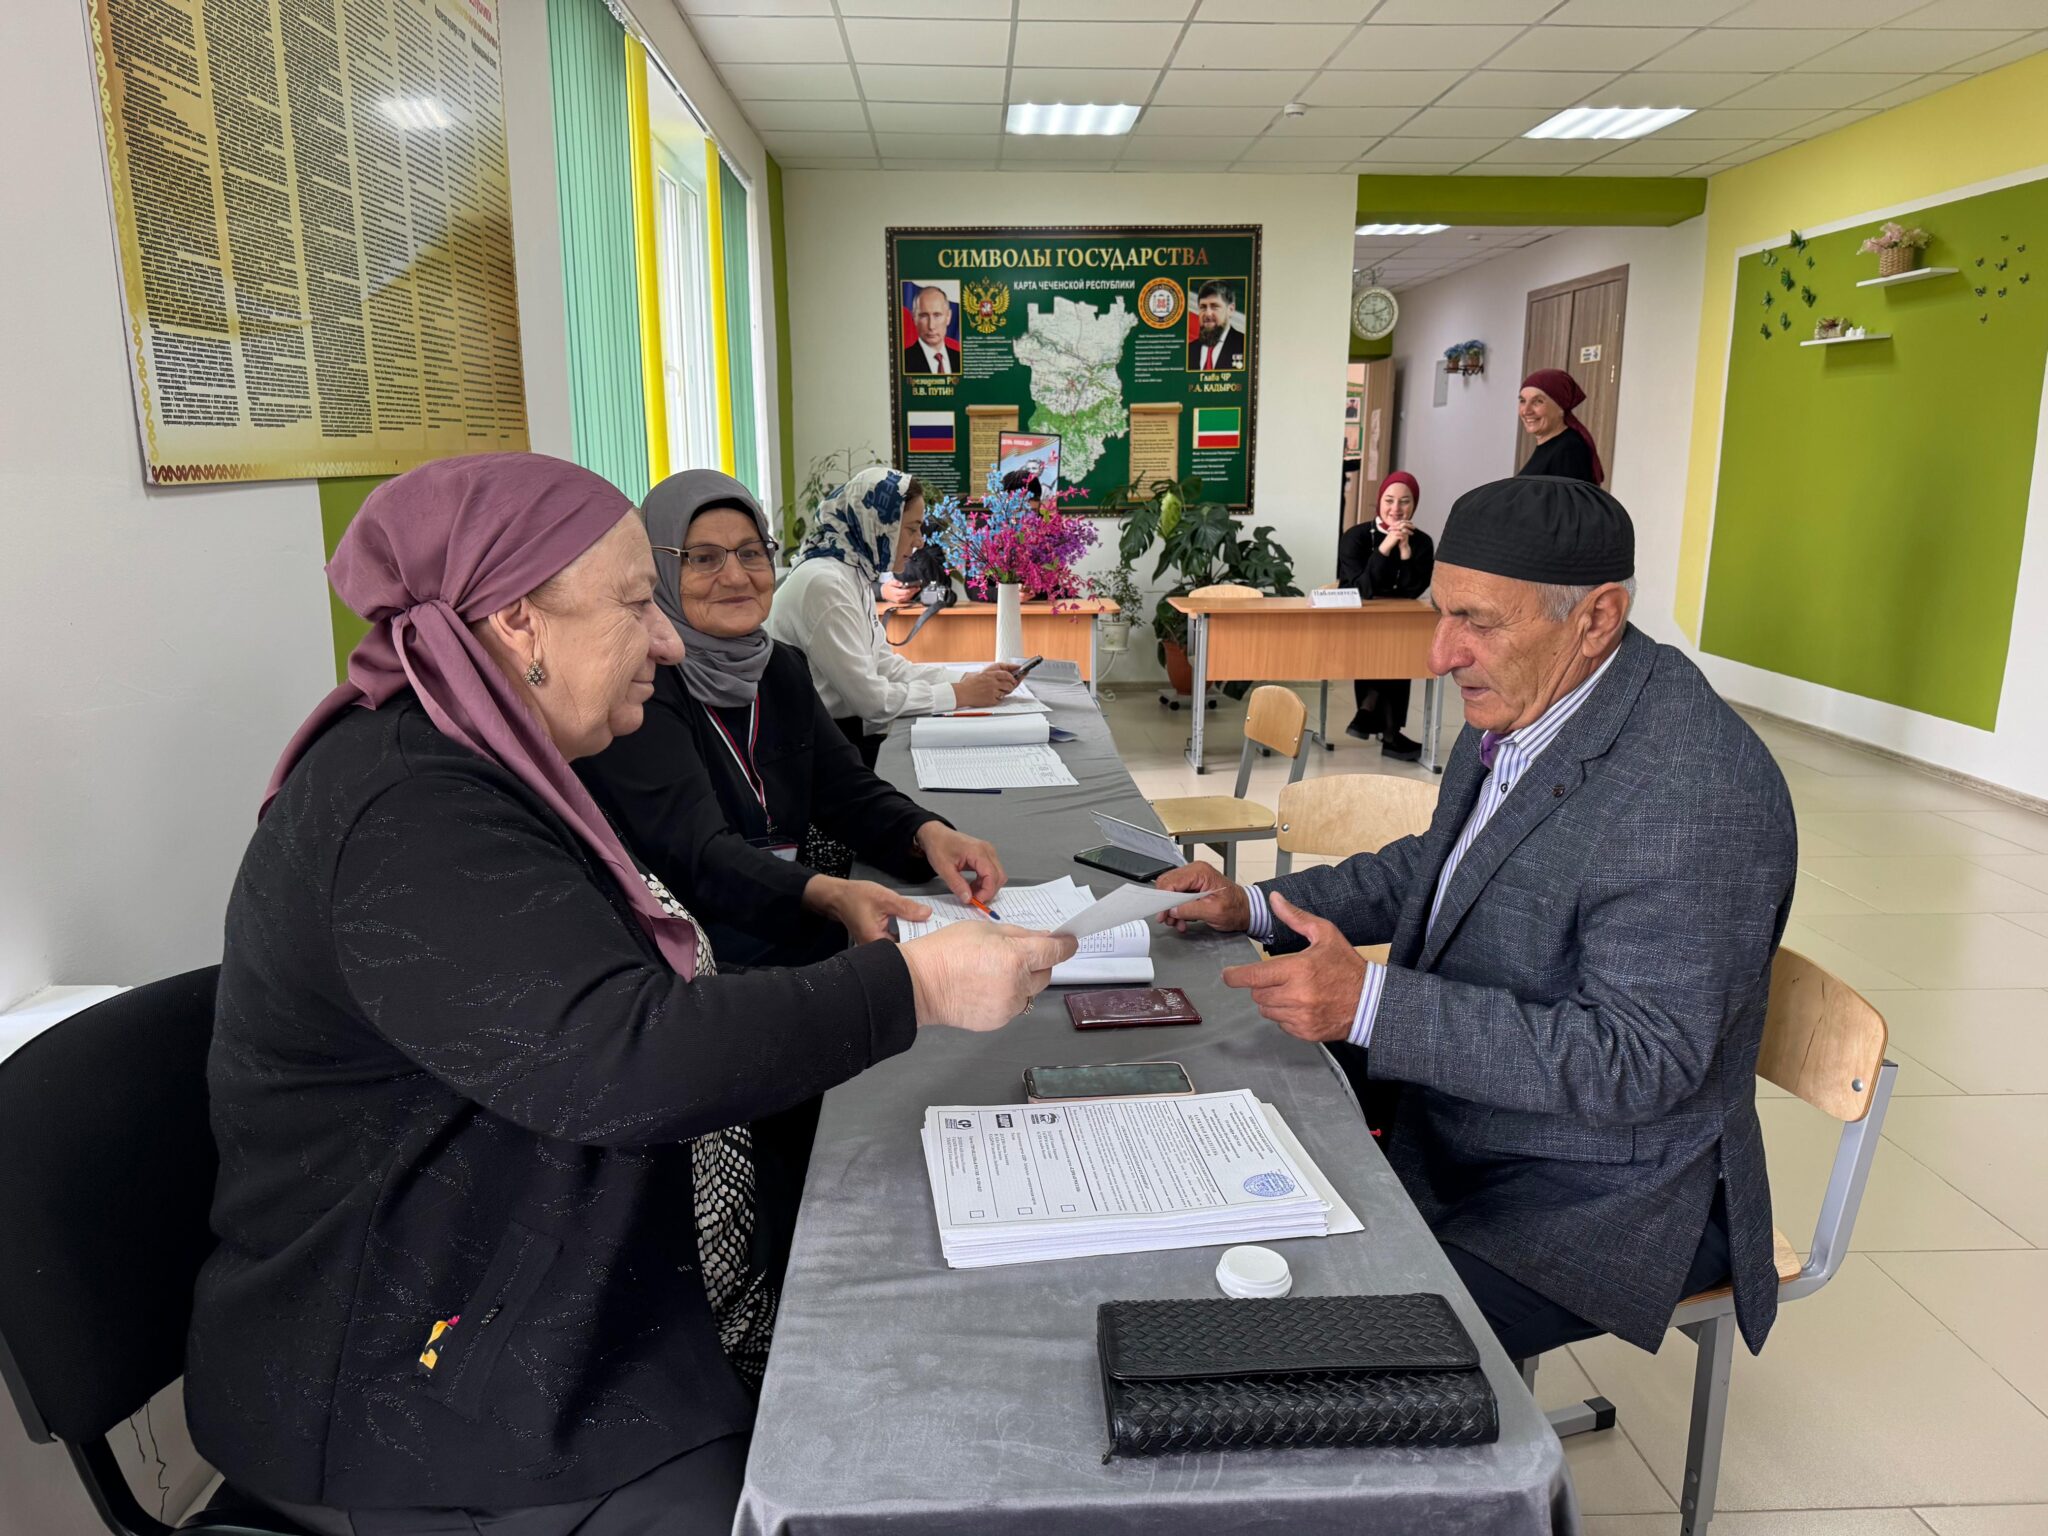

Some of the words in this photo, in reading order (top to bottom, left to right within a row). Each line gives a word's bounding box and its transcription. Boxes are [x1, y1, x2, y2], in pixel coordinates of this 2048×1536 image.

[938, 248, 1052, 268] СИМВОЛЫ
[1055, 247, 1209, 271] ГОСУДАРСТВА
[1013, 281, 1037, 290] КАРТА
[1039, 279, 1084, 290] ЧЕЧЕНСКОЙ
[1085, 280, 1135, 290] РЕСПУБЛИКИ
[928, 387, 955, 396] ПУТИН
